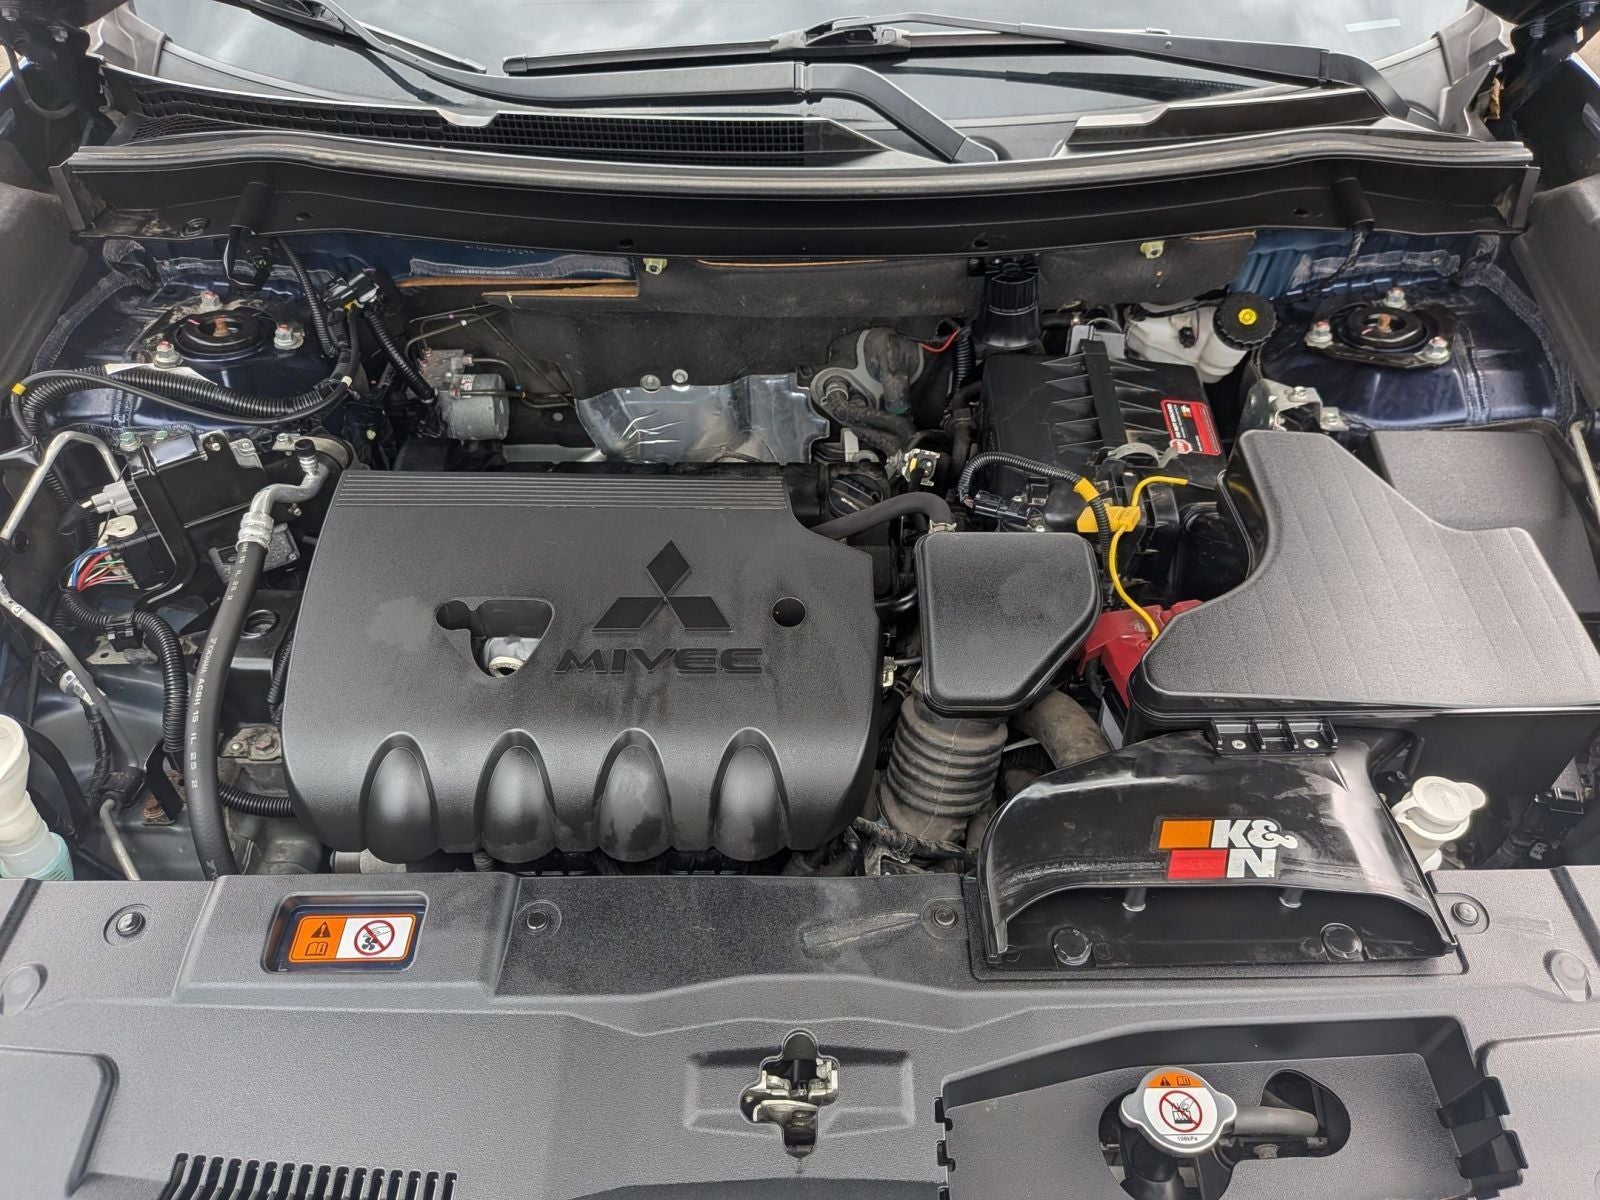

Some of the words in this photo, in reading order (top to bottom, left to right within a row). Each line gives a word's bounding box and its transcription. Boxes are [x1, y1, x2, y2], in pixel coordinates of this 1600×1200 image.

[554, 648, 763, 675] MIVEC
[192, 710, 199, 723] 15
[190, 752, 197, 770] 25
[1226, 848, 1277, 878] N
